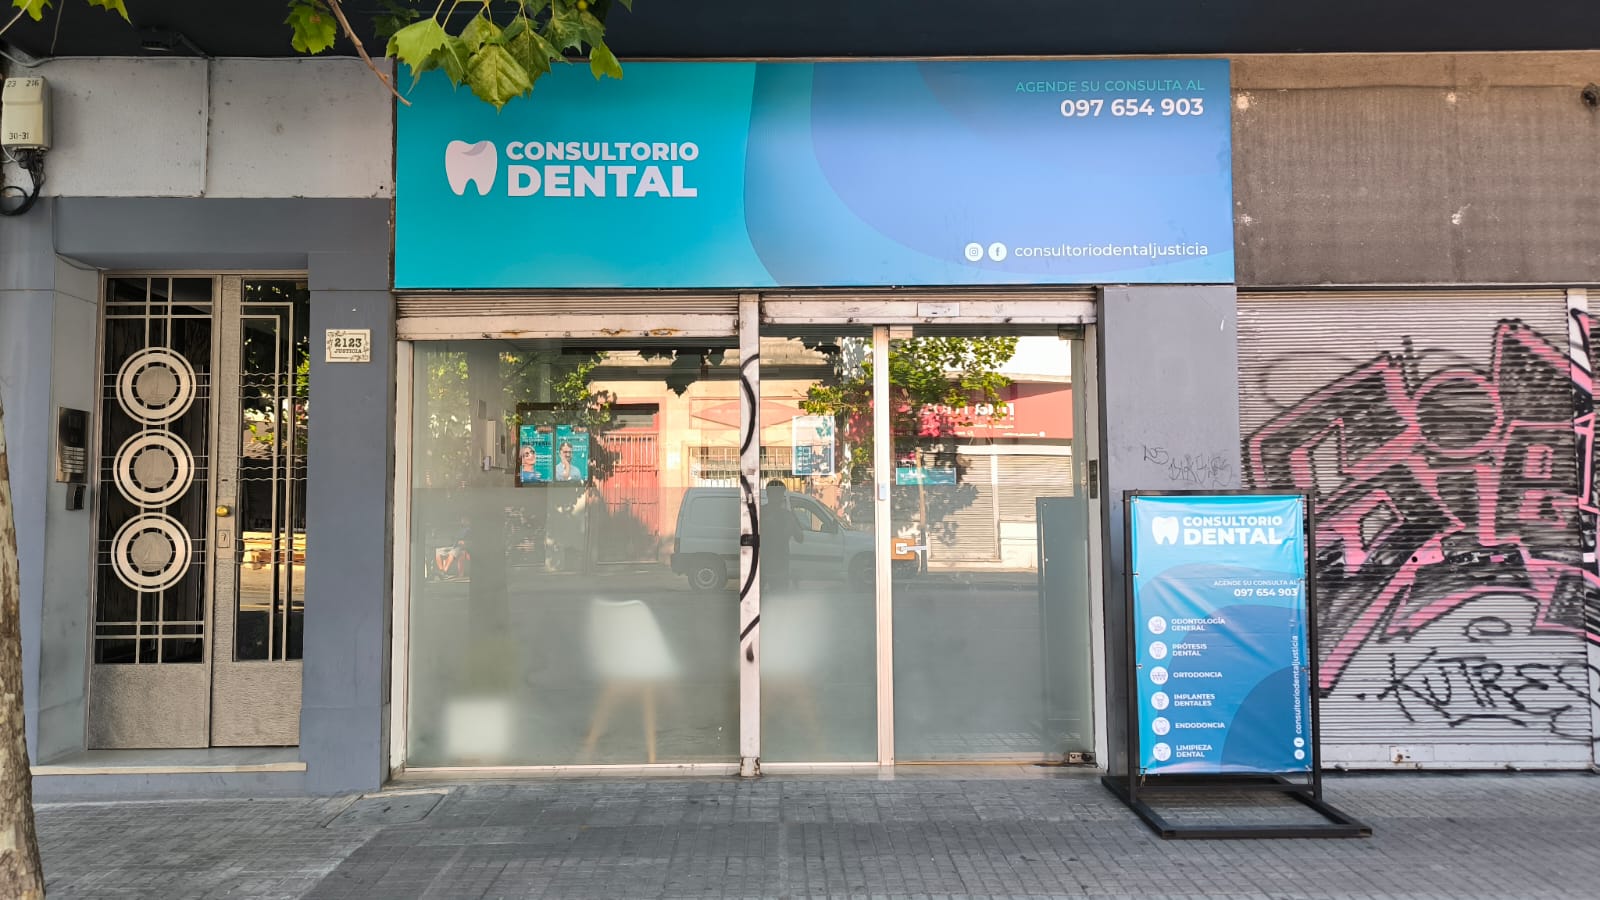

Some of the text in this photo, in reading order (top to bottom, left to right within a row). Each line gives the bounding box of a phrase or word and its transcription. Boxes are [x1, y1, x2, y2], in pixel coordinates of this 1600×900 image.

[1015, 79, 1205, 94] AGENDE SU CONSULTA AL
[1060, 98, 1204, 117] 097 654 903
[506, 141, 699, 161] CONSULTORIO
[507, 164, 698, 198] DENTAL
[1015, 243, 1208, 259] consultoriodentaljusticia
[334, 337, 362, 348] 2123
[1183, 516, 1282, 527] CONSULTORIO
[1183, 528, 1282, 545] DENTAL
[1234, 588, 1298, 597] 097 654 903
[1171, 616, 1225, 625] ODONTOLOGÍA
[1172, 642, 1208, 650] PRÓTESIS
[1292, 635, 1302, 734] consultoriodentaljusticia
[1173, 693, 1216, 701] IMPLANTES
